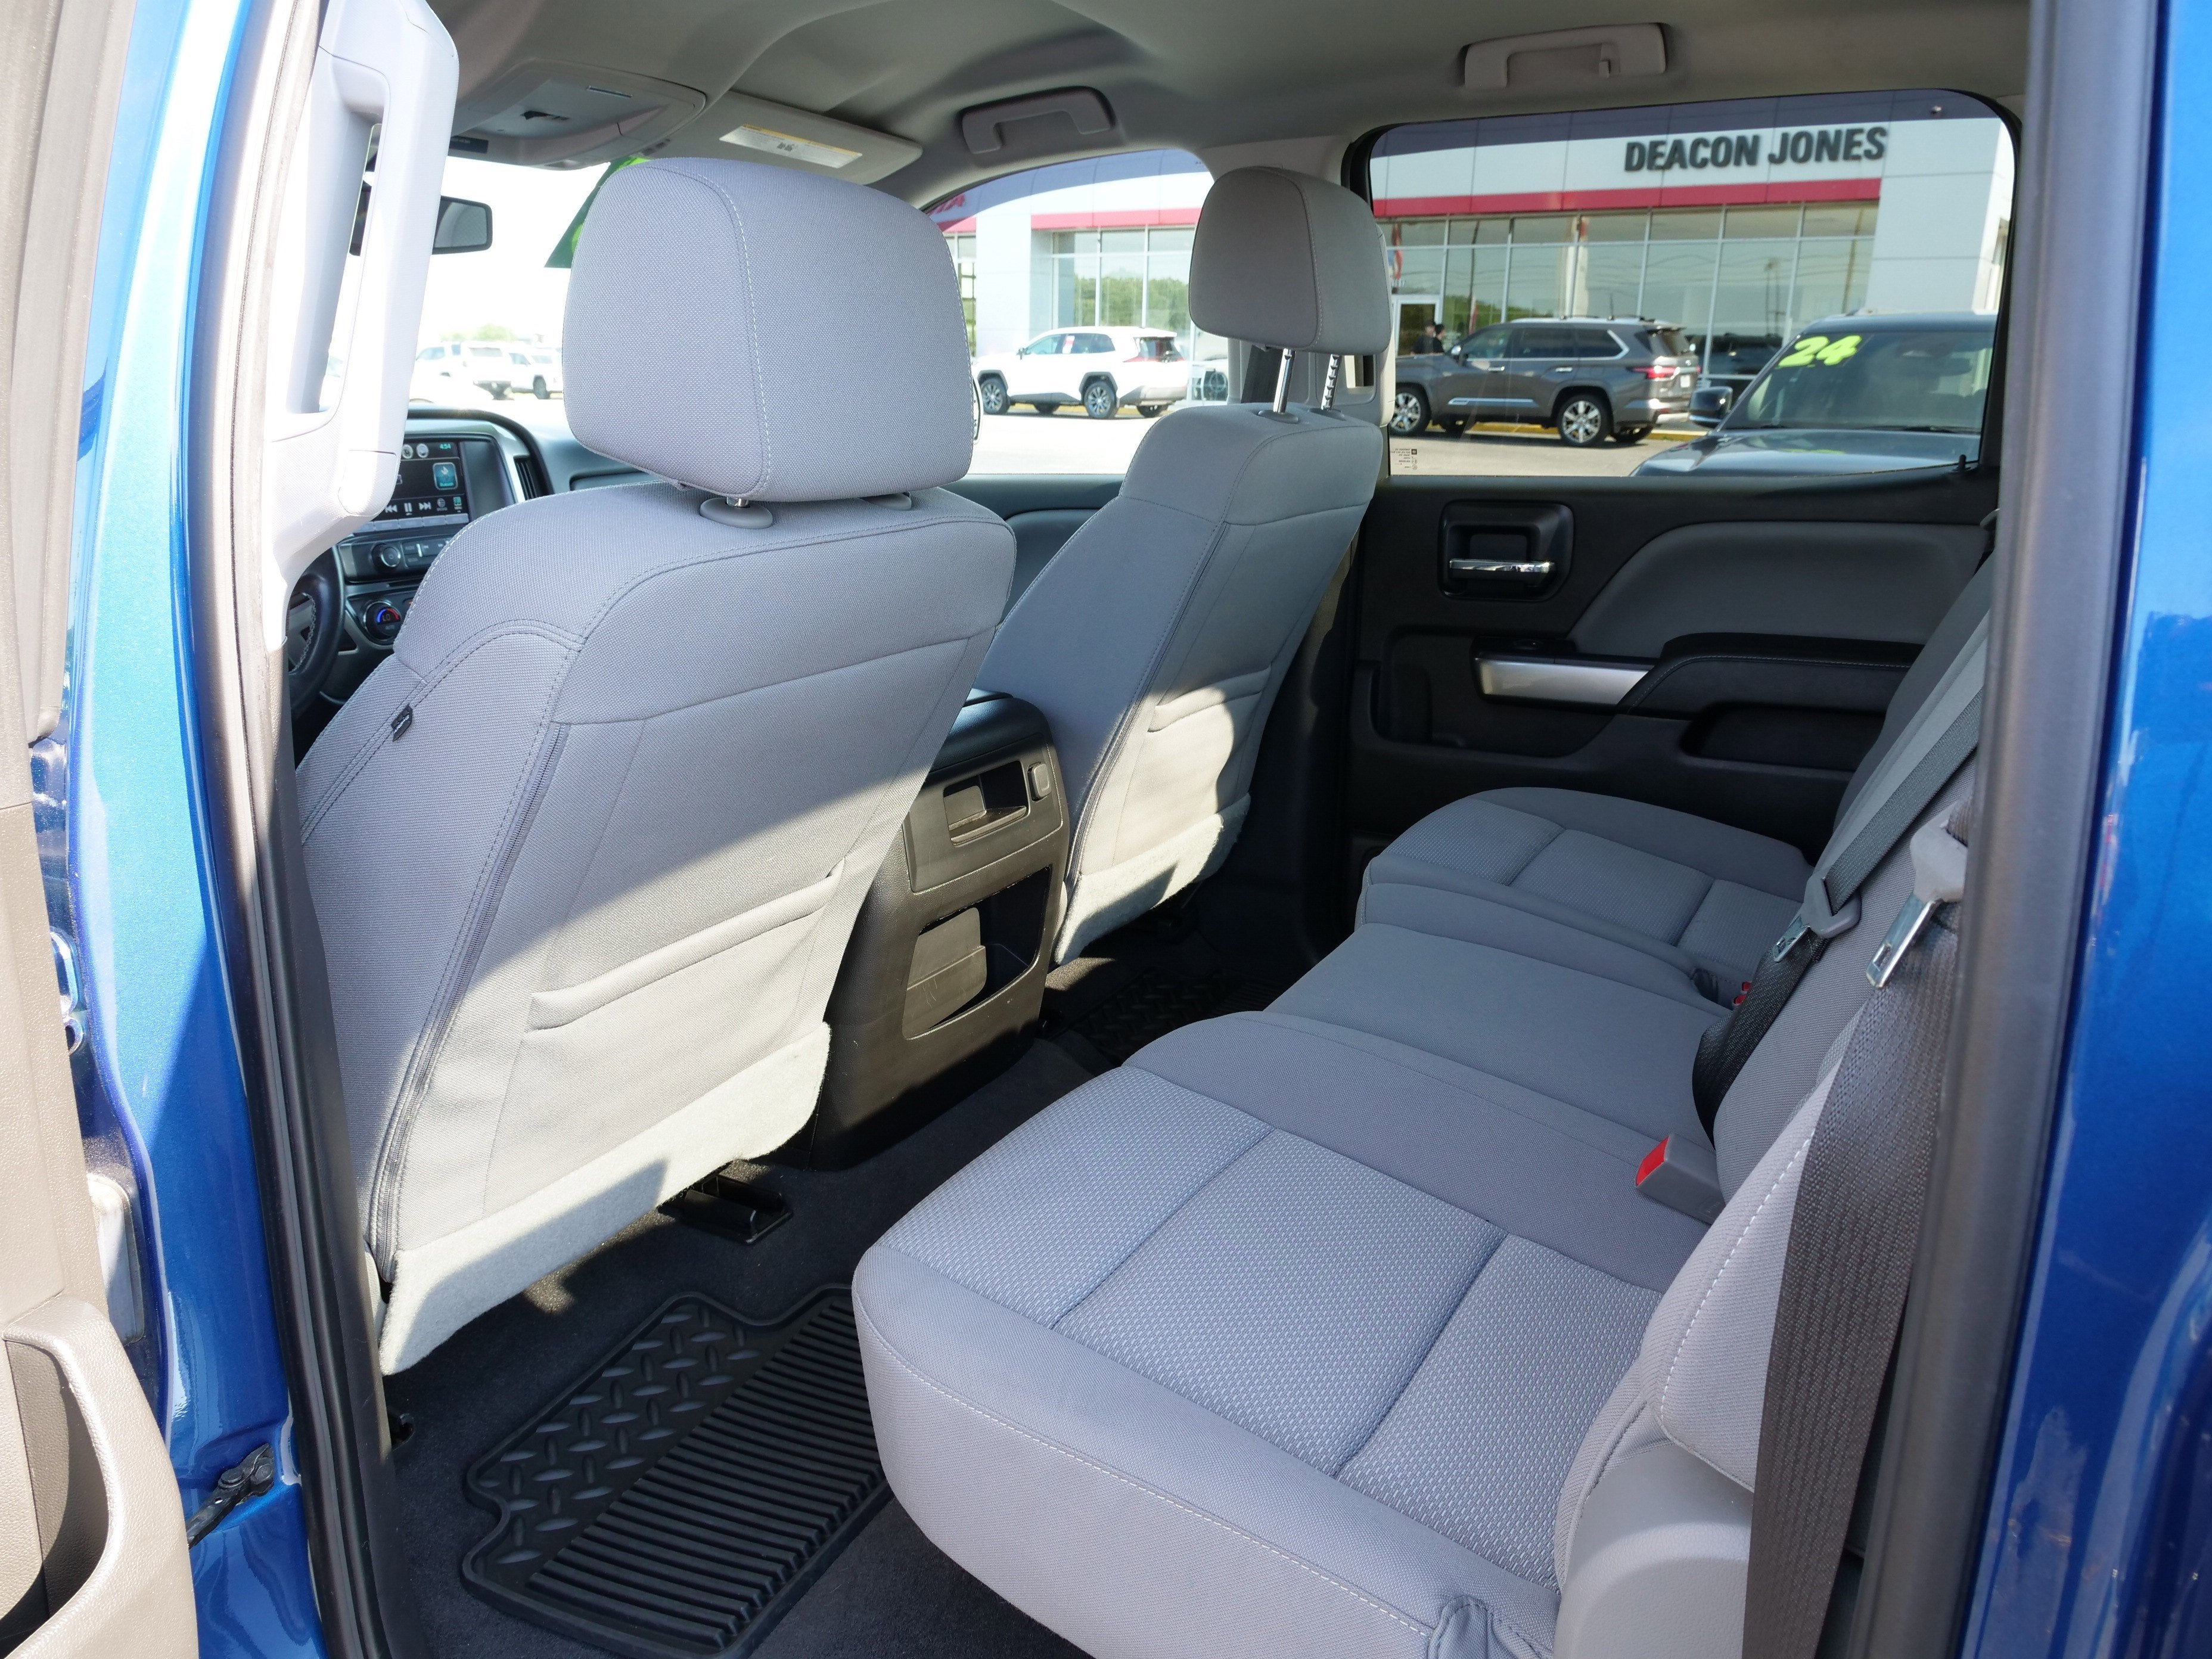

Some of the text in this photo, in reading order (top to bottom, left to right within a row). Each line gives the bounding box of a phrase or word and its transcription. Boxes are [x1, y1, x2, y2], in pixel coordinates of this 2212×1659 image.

[1624, 126, 1888, 172] DEACON JONES
[1776, 335, 1862, 368] 24
